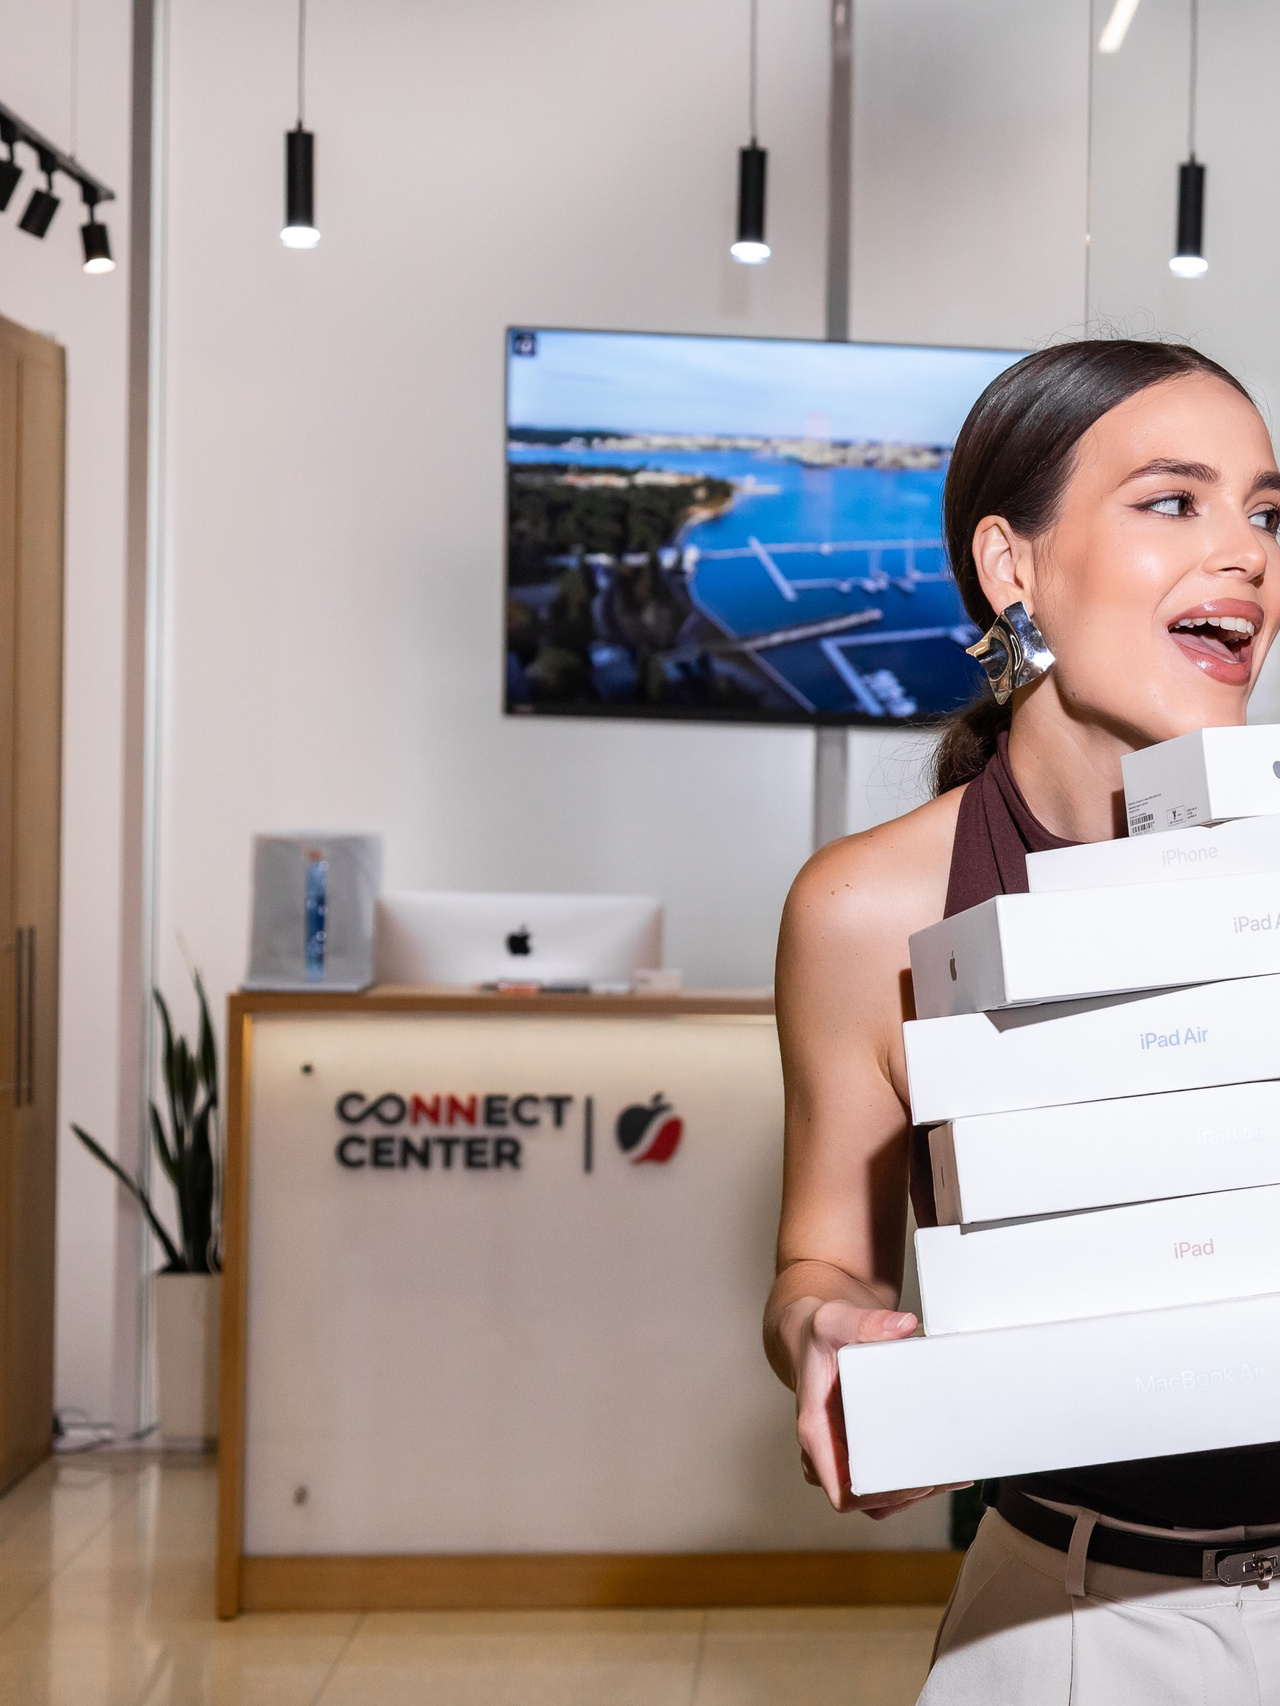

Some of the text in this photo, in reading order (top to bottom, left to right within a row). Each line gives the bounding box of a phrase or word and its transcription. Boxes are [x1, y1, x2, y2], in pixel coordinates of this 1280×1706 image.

[1162, 846, 1218, 866] iPhone
[1233, 914, 1272, 933] iPad
[1140, 1026, 1208, 1050] iPad Air
[335, 1092, 573, 1127] CONNECT
[336, 1136, 521, 1170] CENTER
[1173, 1239, 1215, 1259] iPad
[1135, 1361, 1267, 1394] MacBook Air
